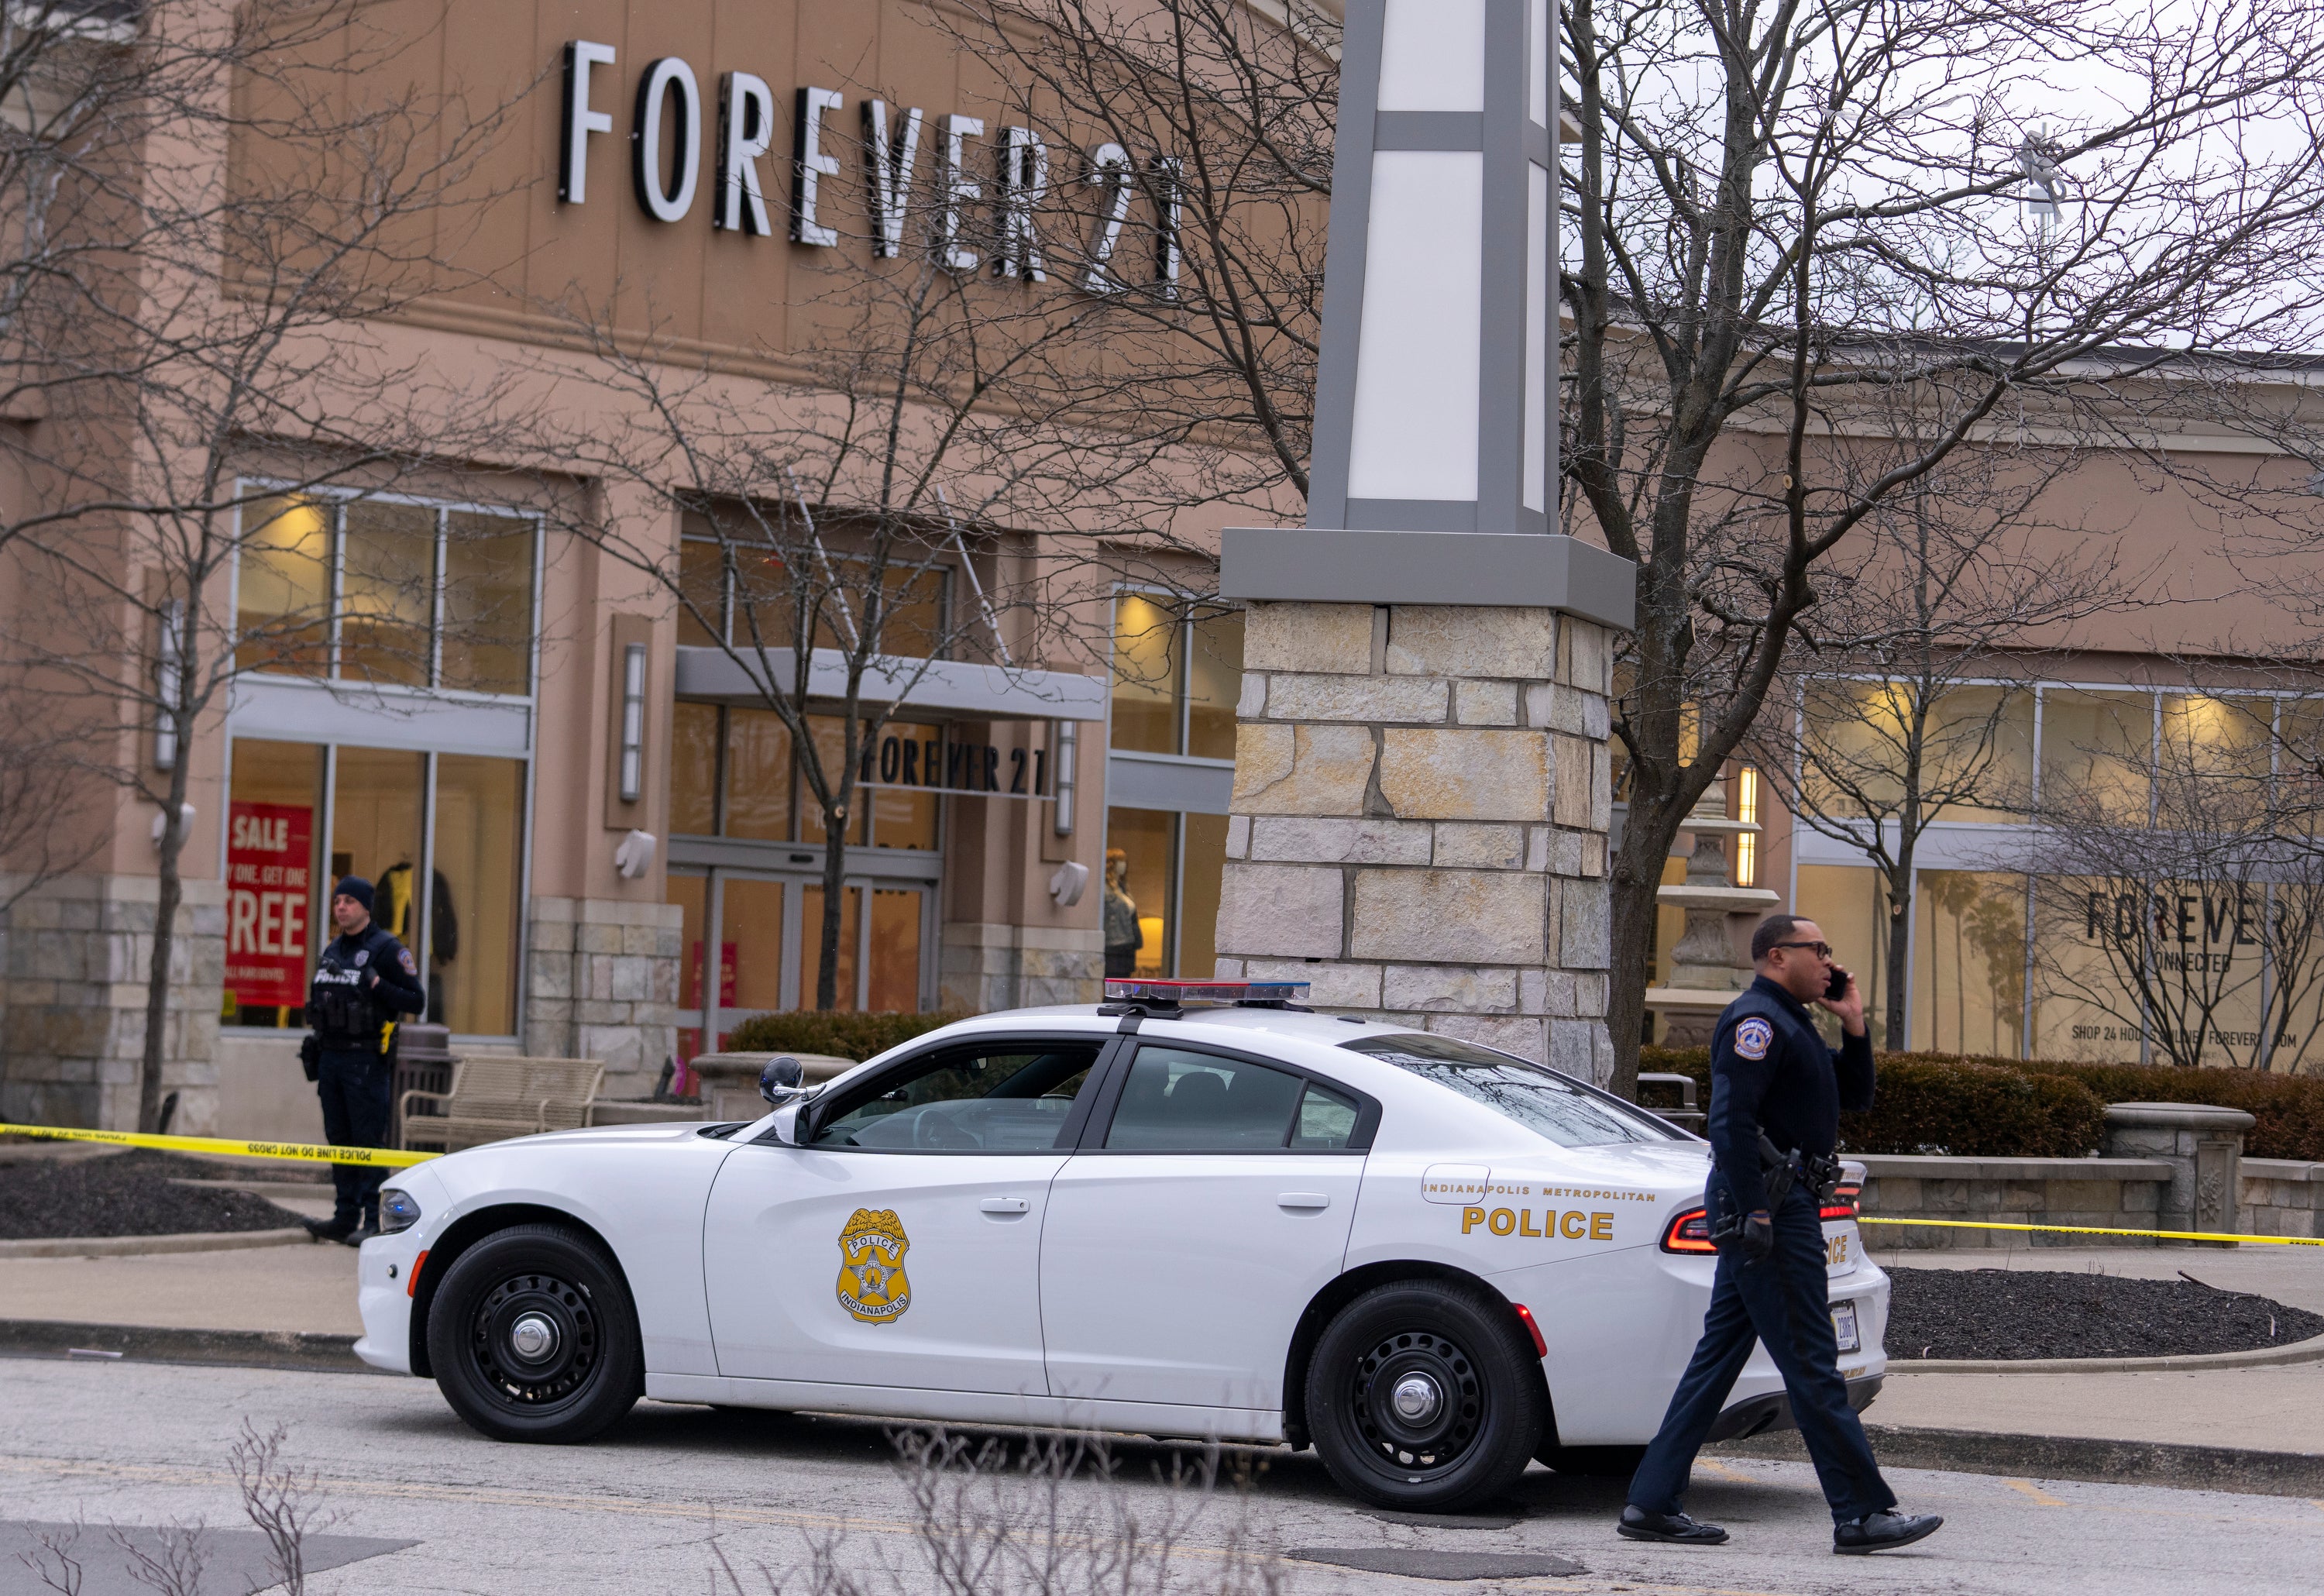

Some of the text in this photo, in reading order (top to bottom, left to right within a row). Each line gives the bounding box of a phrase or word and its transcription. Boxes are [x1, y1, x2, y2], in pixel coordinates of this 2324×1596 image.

[558, 39, 1184, 301] FOREVER 21
[860, 734, 1046, 796] FOREVER 21
[233, 815, 289, 851] SALE
[286, 867, 308, 887] ONE
[229, 889, 306, 955] REE
[2153, 951, 2231, 972] ONNECTED
[2071, 1025, 2101, 1040] SHOP
[2104, 1027, 2116, 1040] 24
[2119, 1027, 2157, 1043] HOUS
[248, 1143, 372, 1161] POLICE LINE DO NOT CROSS
[1423, 1183, 1656, 1202] INDIANAPOLIS METROPOLITAN
[1461, 1206, 1614, 1240] POLICE
[853, 1236, 897, 1253] POLICE
[1827, 1234, 1848, 1265] ICE
[841, 1293, 907, 1316] INDIANAPOLIS
